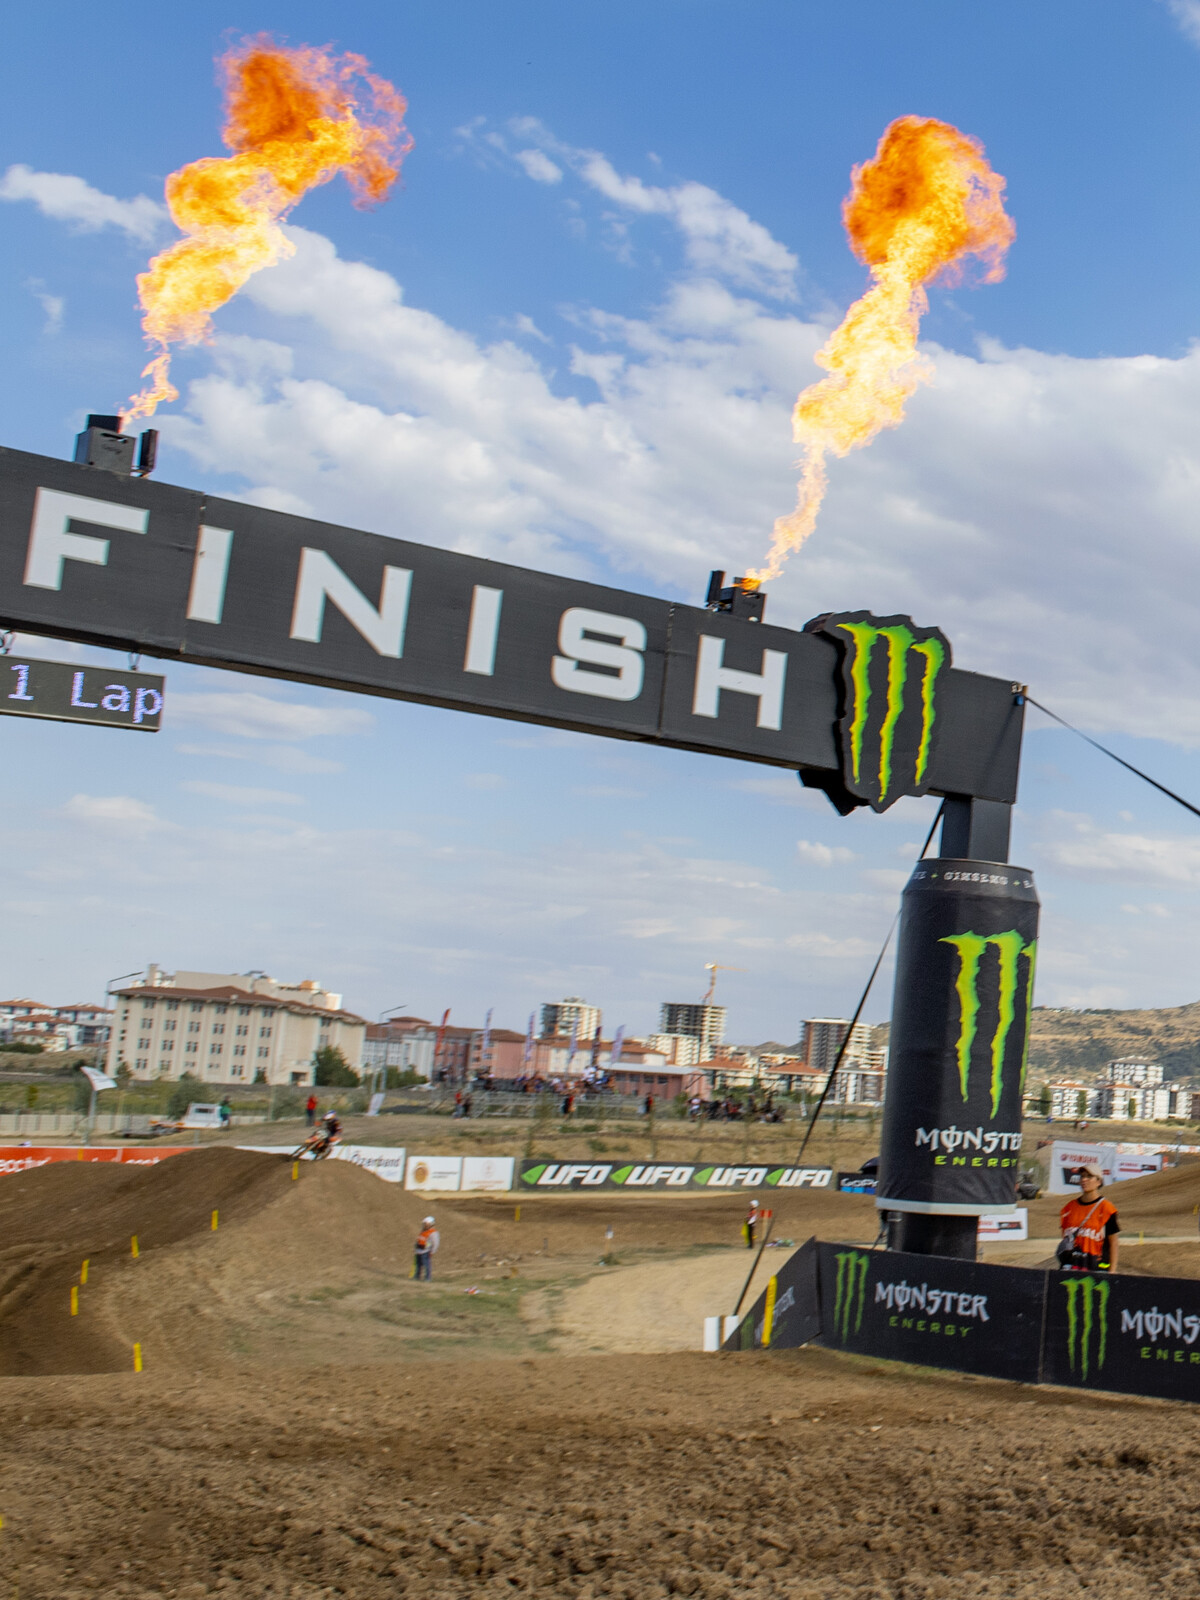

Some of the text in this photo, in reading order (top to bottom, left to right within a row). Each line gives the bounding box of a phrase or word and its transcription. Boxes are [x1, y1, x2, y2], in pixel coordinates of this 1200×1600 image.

[23, 486, 788, 730] FINISH
[7, 664, 163, 724] 1 Lap
[934, 1155, 1018, 1168] ENERGY
[537, 1164, 613, 1186] UFO
[624, 1165, 696, 1187] UFO
[707, 1167, 769, 1187] UFO
[777, 1168, 834, 1188] UFO
[874, 1280, 990, 1322] MONSTER
[888, 1315, 975, 1338] ENERGY
